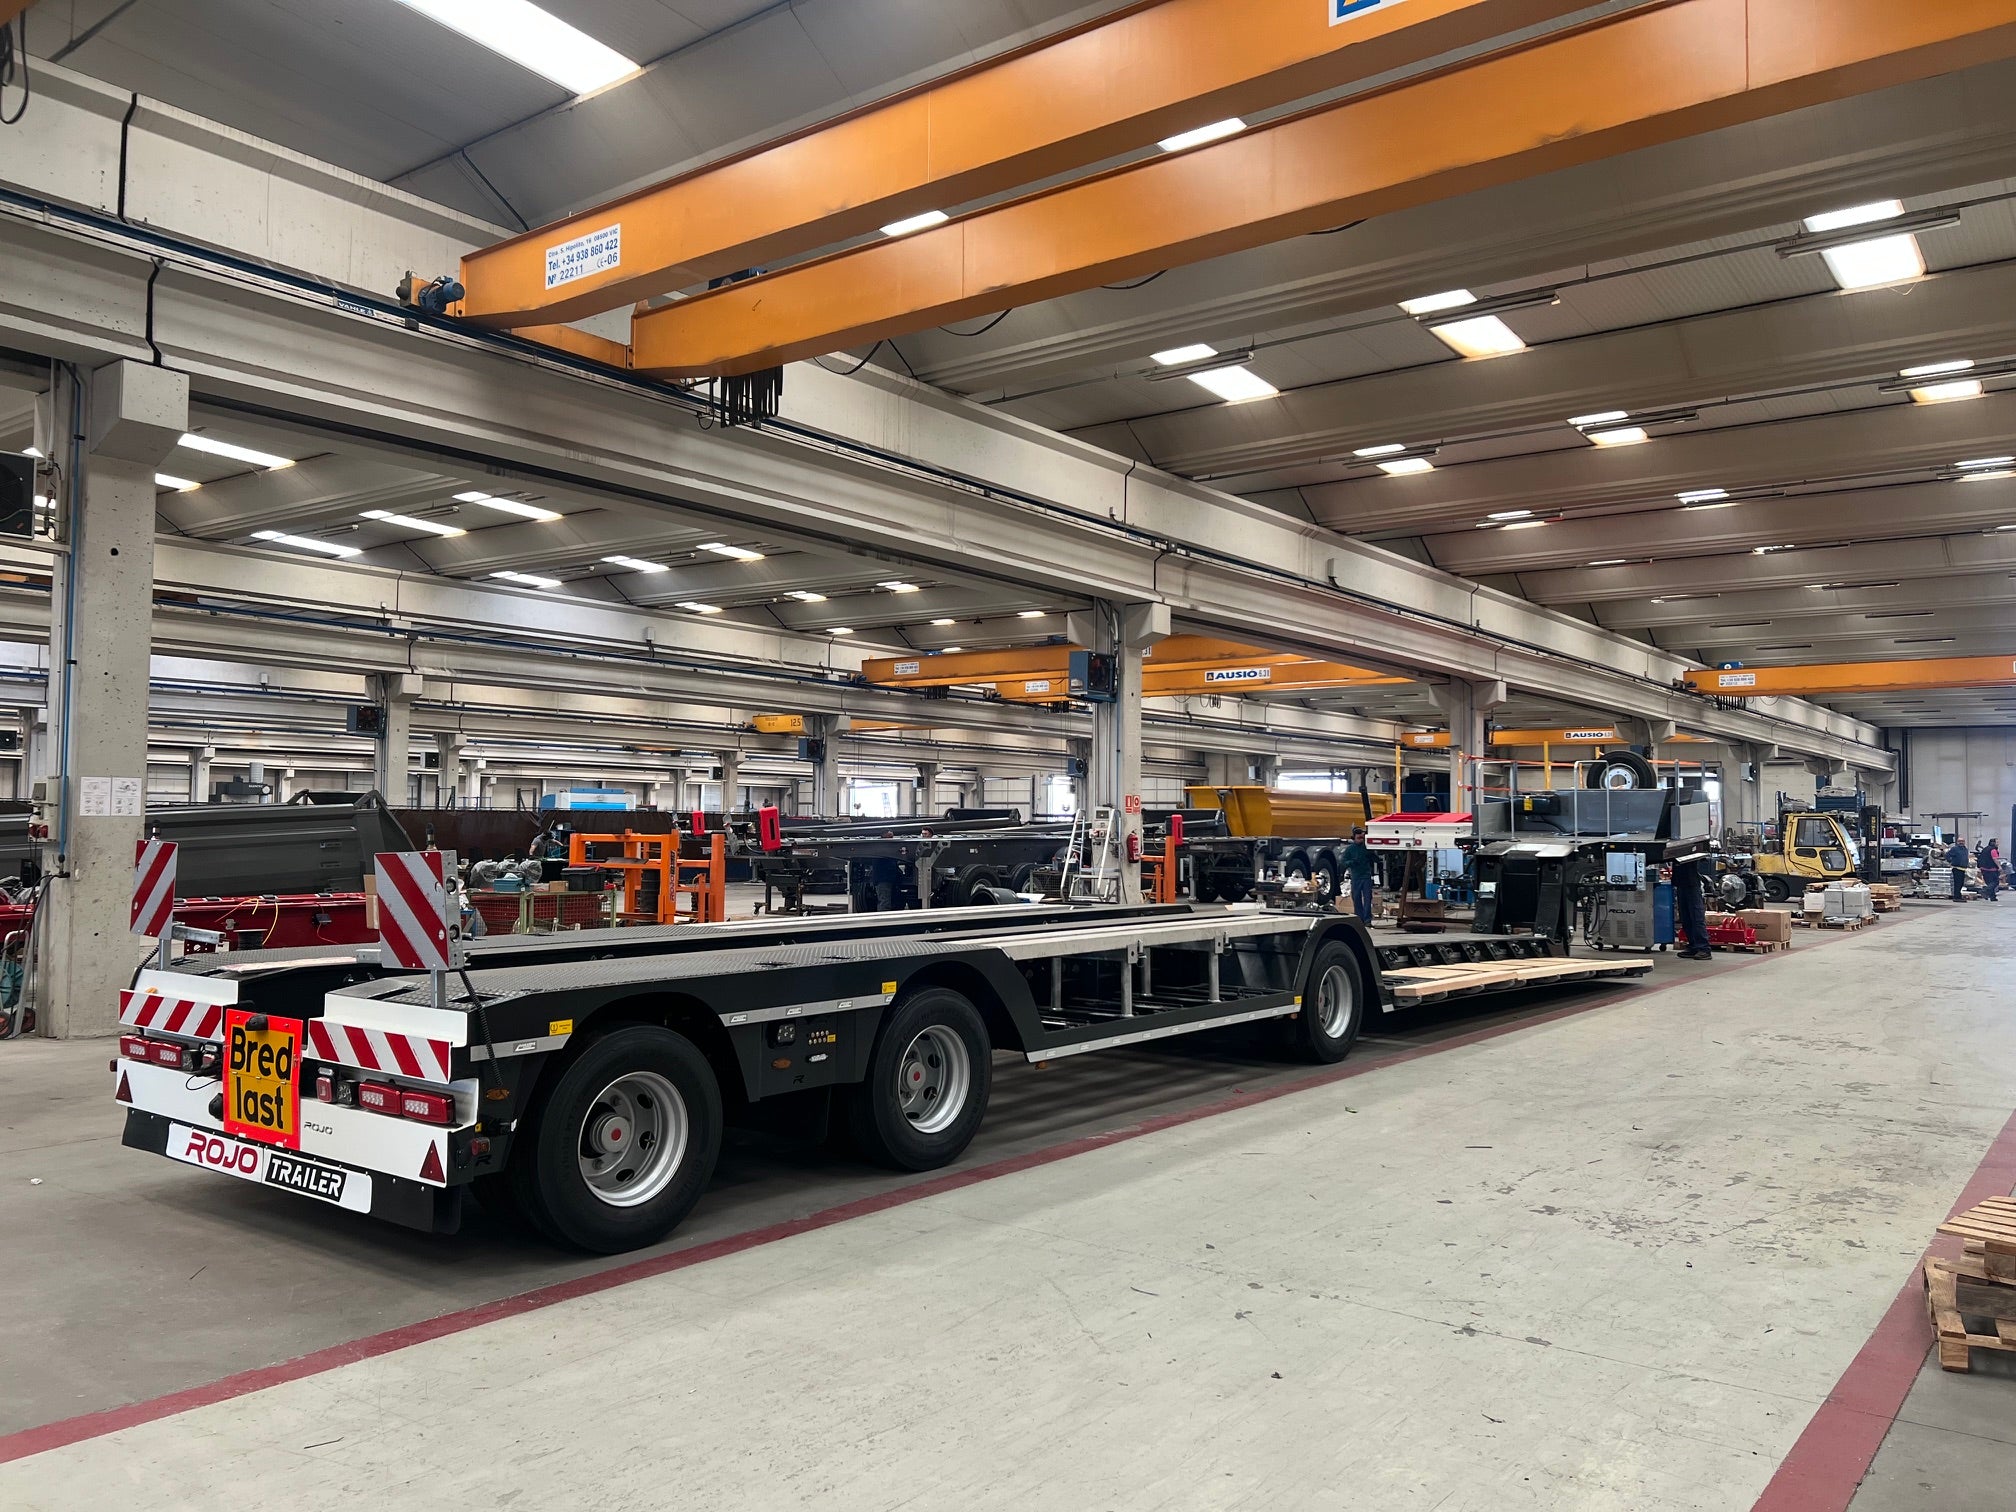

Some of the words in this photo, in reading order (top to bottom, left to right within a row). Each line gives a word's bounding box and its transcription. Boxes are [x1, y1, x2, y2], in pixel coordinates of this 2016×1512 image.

[609, 228, 618, 236] VIC
[549, 258, 560, 271] Tel.
[562, 253, 575, 265] +34
[576, 248, 589, 261] 938
[590, 243, 603, 257] 860
[605, 238, 618, 251] 422
[560, 264, 583, 280] 22211
[230, 1026, 293, 1081] Bred
[235, 1076, 284, 1129] last
[304, 1121, 333, 1135] ROJO
[185, 1132, 258, 1174] ROJO
[270, 1158, 342, 1197] TRAILER
